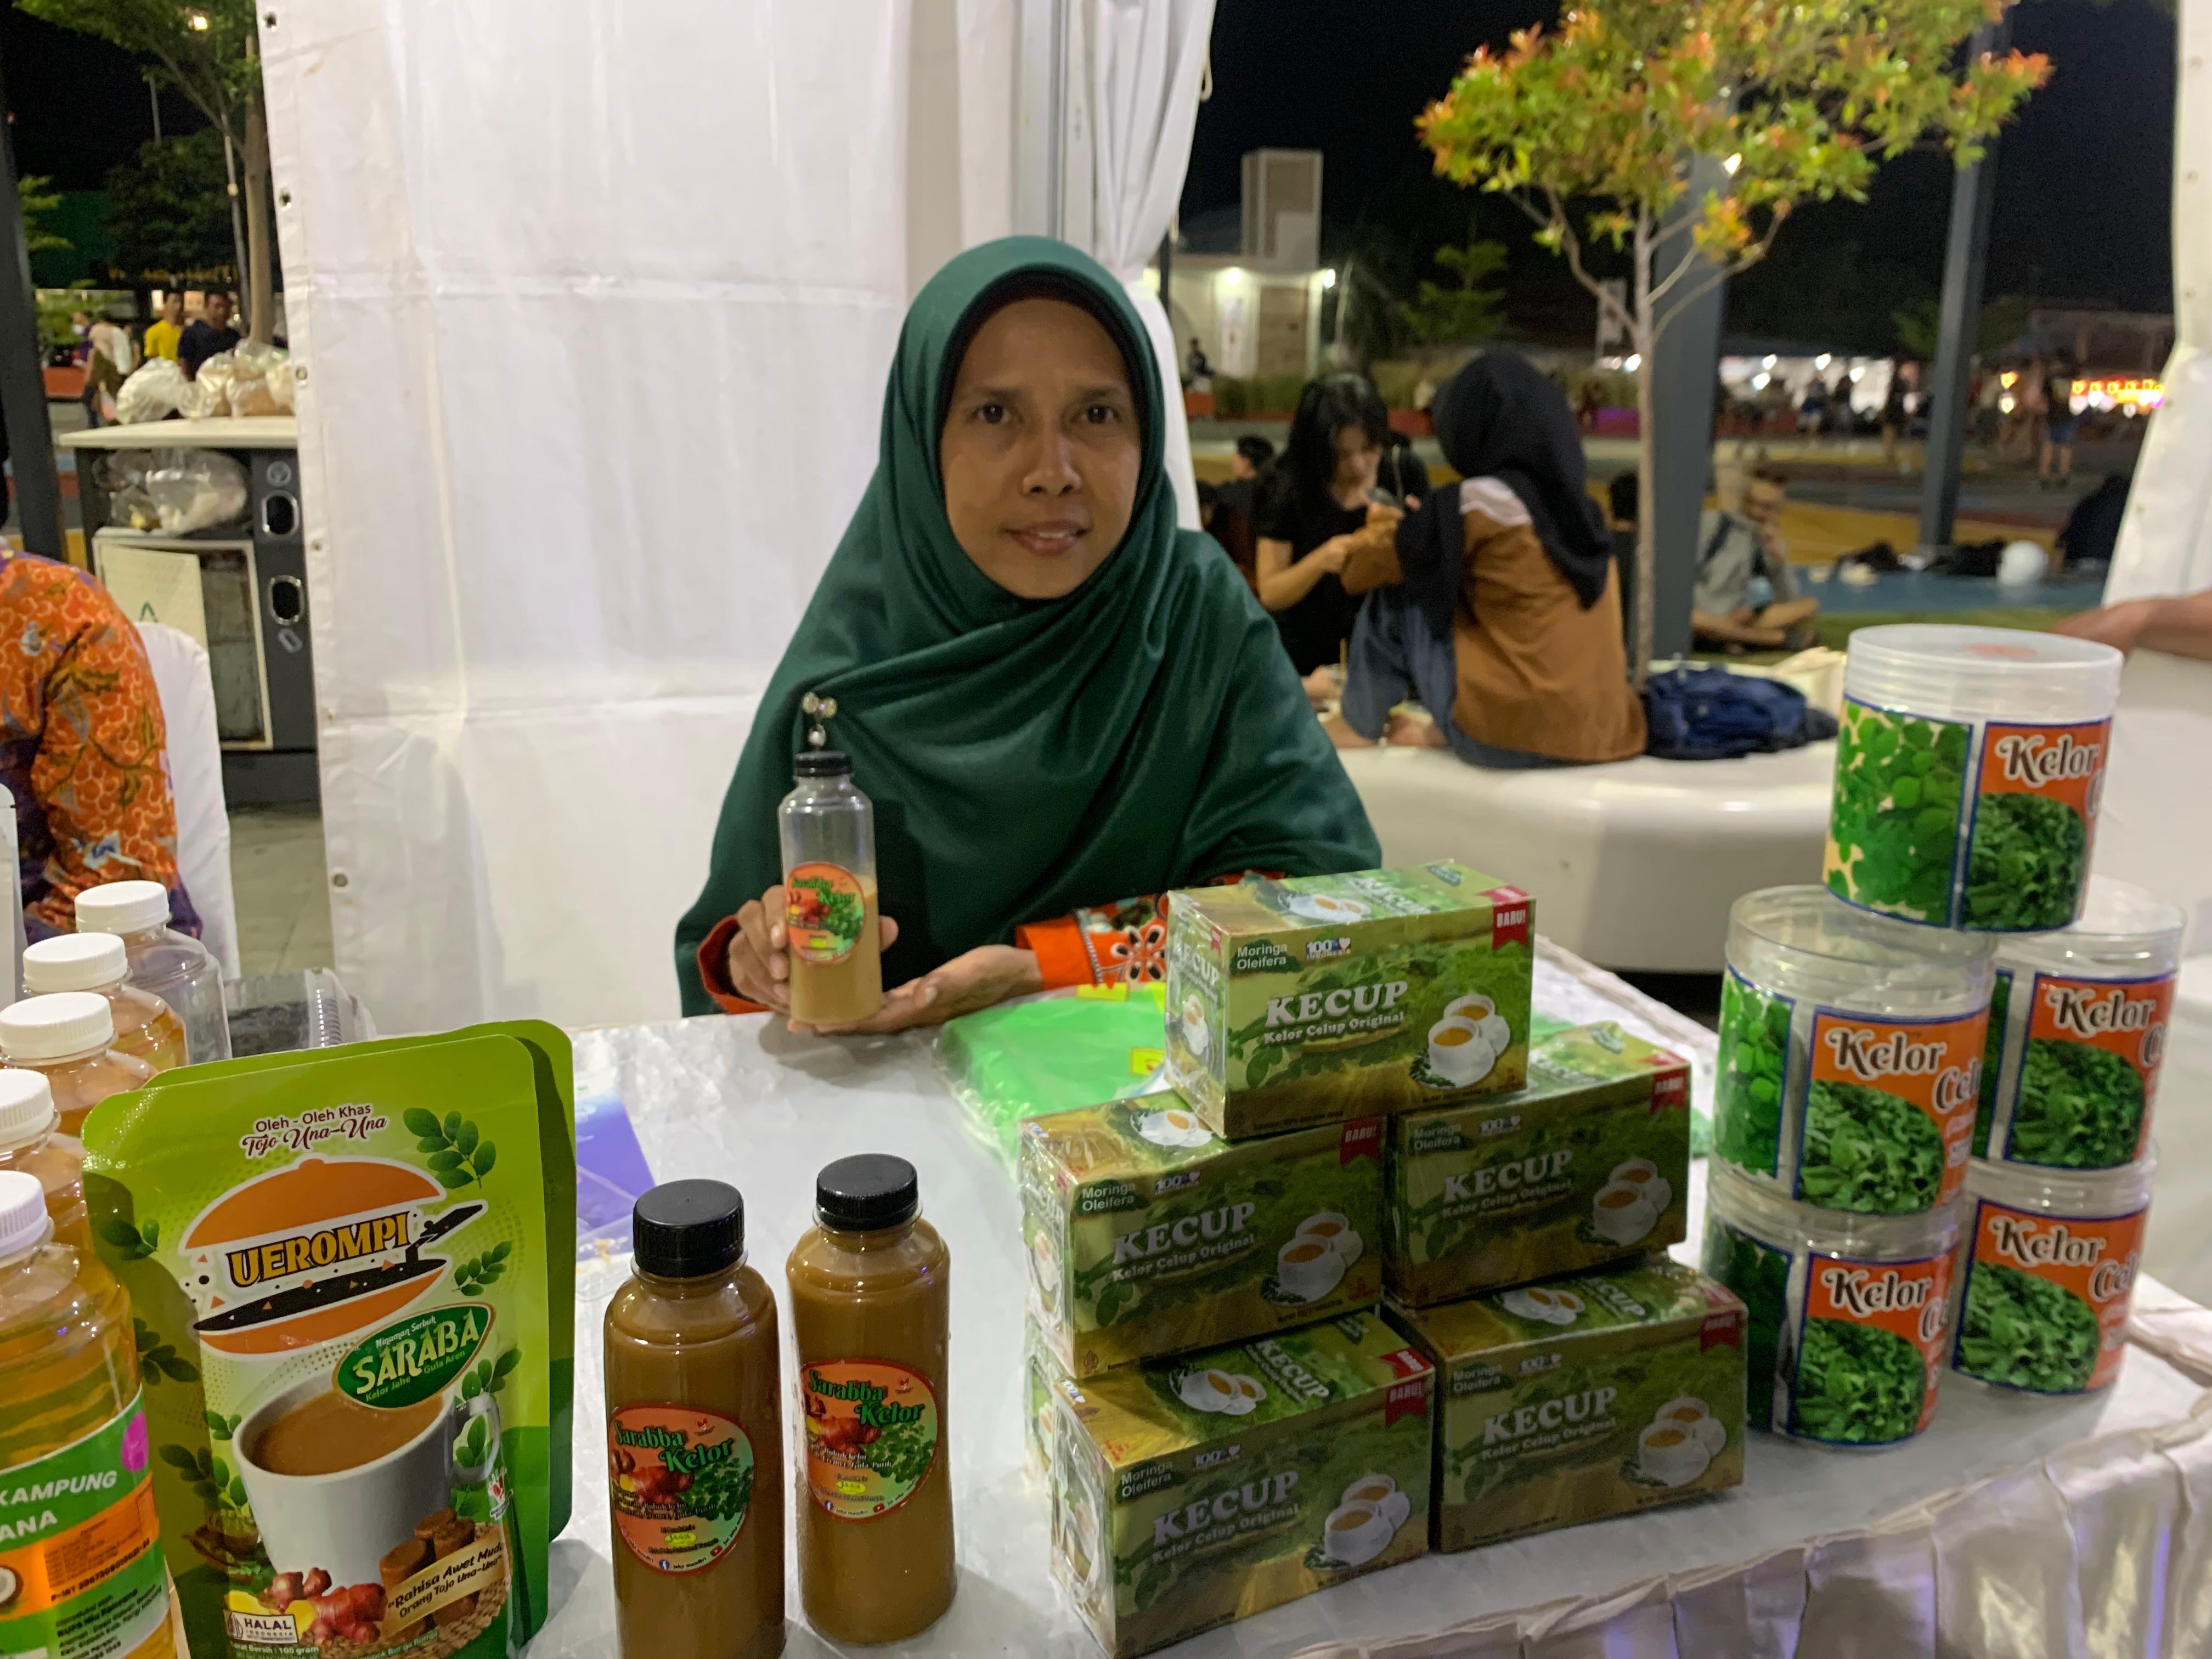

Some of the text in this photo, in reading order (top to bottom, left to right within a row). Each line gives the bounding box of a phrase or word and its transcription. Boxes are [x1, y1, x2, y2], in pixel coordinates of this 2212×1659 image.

[1995, 735, 2100, 787] Kelor
[1497, 909, 1526, 928] BARU!
[1237, 944, 1288, 958] Moringa
[1237, 956, 1286, 969] Oleifera
[1265, 980, 1408, 1027] KECUP
[2045, 988, 2157, 1038] Kelor
[1264, 1012, 1404, 1043] Kelor Celup Original
[1825, 1028, 1947, 1080] Kelor
[242, 1116, 387, 1156] Tojo Una-Una
[256, 1118, 289, 1132] Oleh
[302, 1109, 335, 1124] Oleh
[339, 1105, 371, 1118] Khas
[1082, 1183, 1136, 1199] Moringa
[1443, 1149, 1573, 1203] KECUP
[1082, 1195, 1135, 1211] Oleifera
[225, 1210, 410, 1287] UEROMPI
[1113, 1202, 1255, 1264] KECUP
[1988, 1216, 2106, 1267] Kelor
[1112, 1263, 1153, 1281] Kelor
[1200, 1234, 1254, 1257] Original
[1821, 1268, 1932, 1318] Kelor
[376, 1315, 437, 1348] Minuman Serbuk
[353, 1308, 480, 1395] SARABA
[424, 1350, 465, 1374] Gula Aren
[1256, 1339, 1329, 1397] KECUP
[365, 1375, 411, 1402] Kelor Jahe
[808, 1369, 884, 1402] Sarabba
[854, 1401, 926, 1429] Kelor
[1484, 1386, 1617, 1445] KECUP
[614, 1420, 685, 1448] Sarabba
[658, 1437, 734, 1474] Kelor
[1122, 1462, 1173, 1485] Moringa
[0, 1470, 117, 1506] KAMPUNG
[1154, 1471, 1299, 1547] KECUP
[443, 1555, 475, 1579] Awet
[399, 1593, 433, 1618] Orang
[433, 1579, 455, 1595] Tojo
[244, 1618, 292, 1630] HALAL
